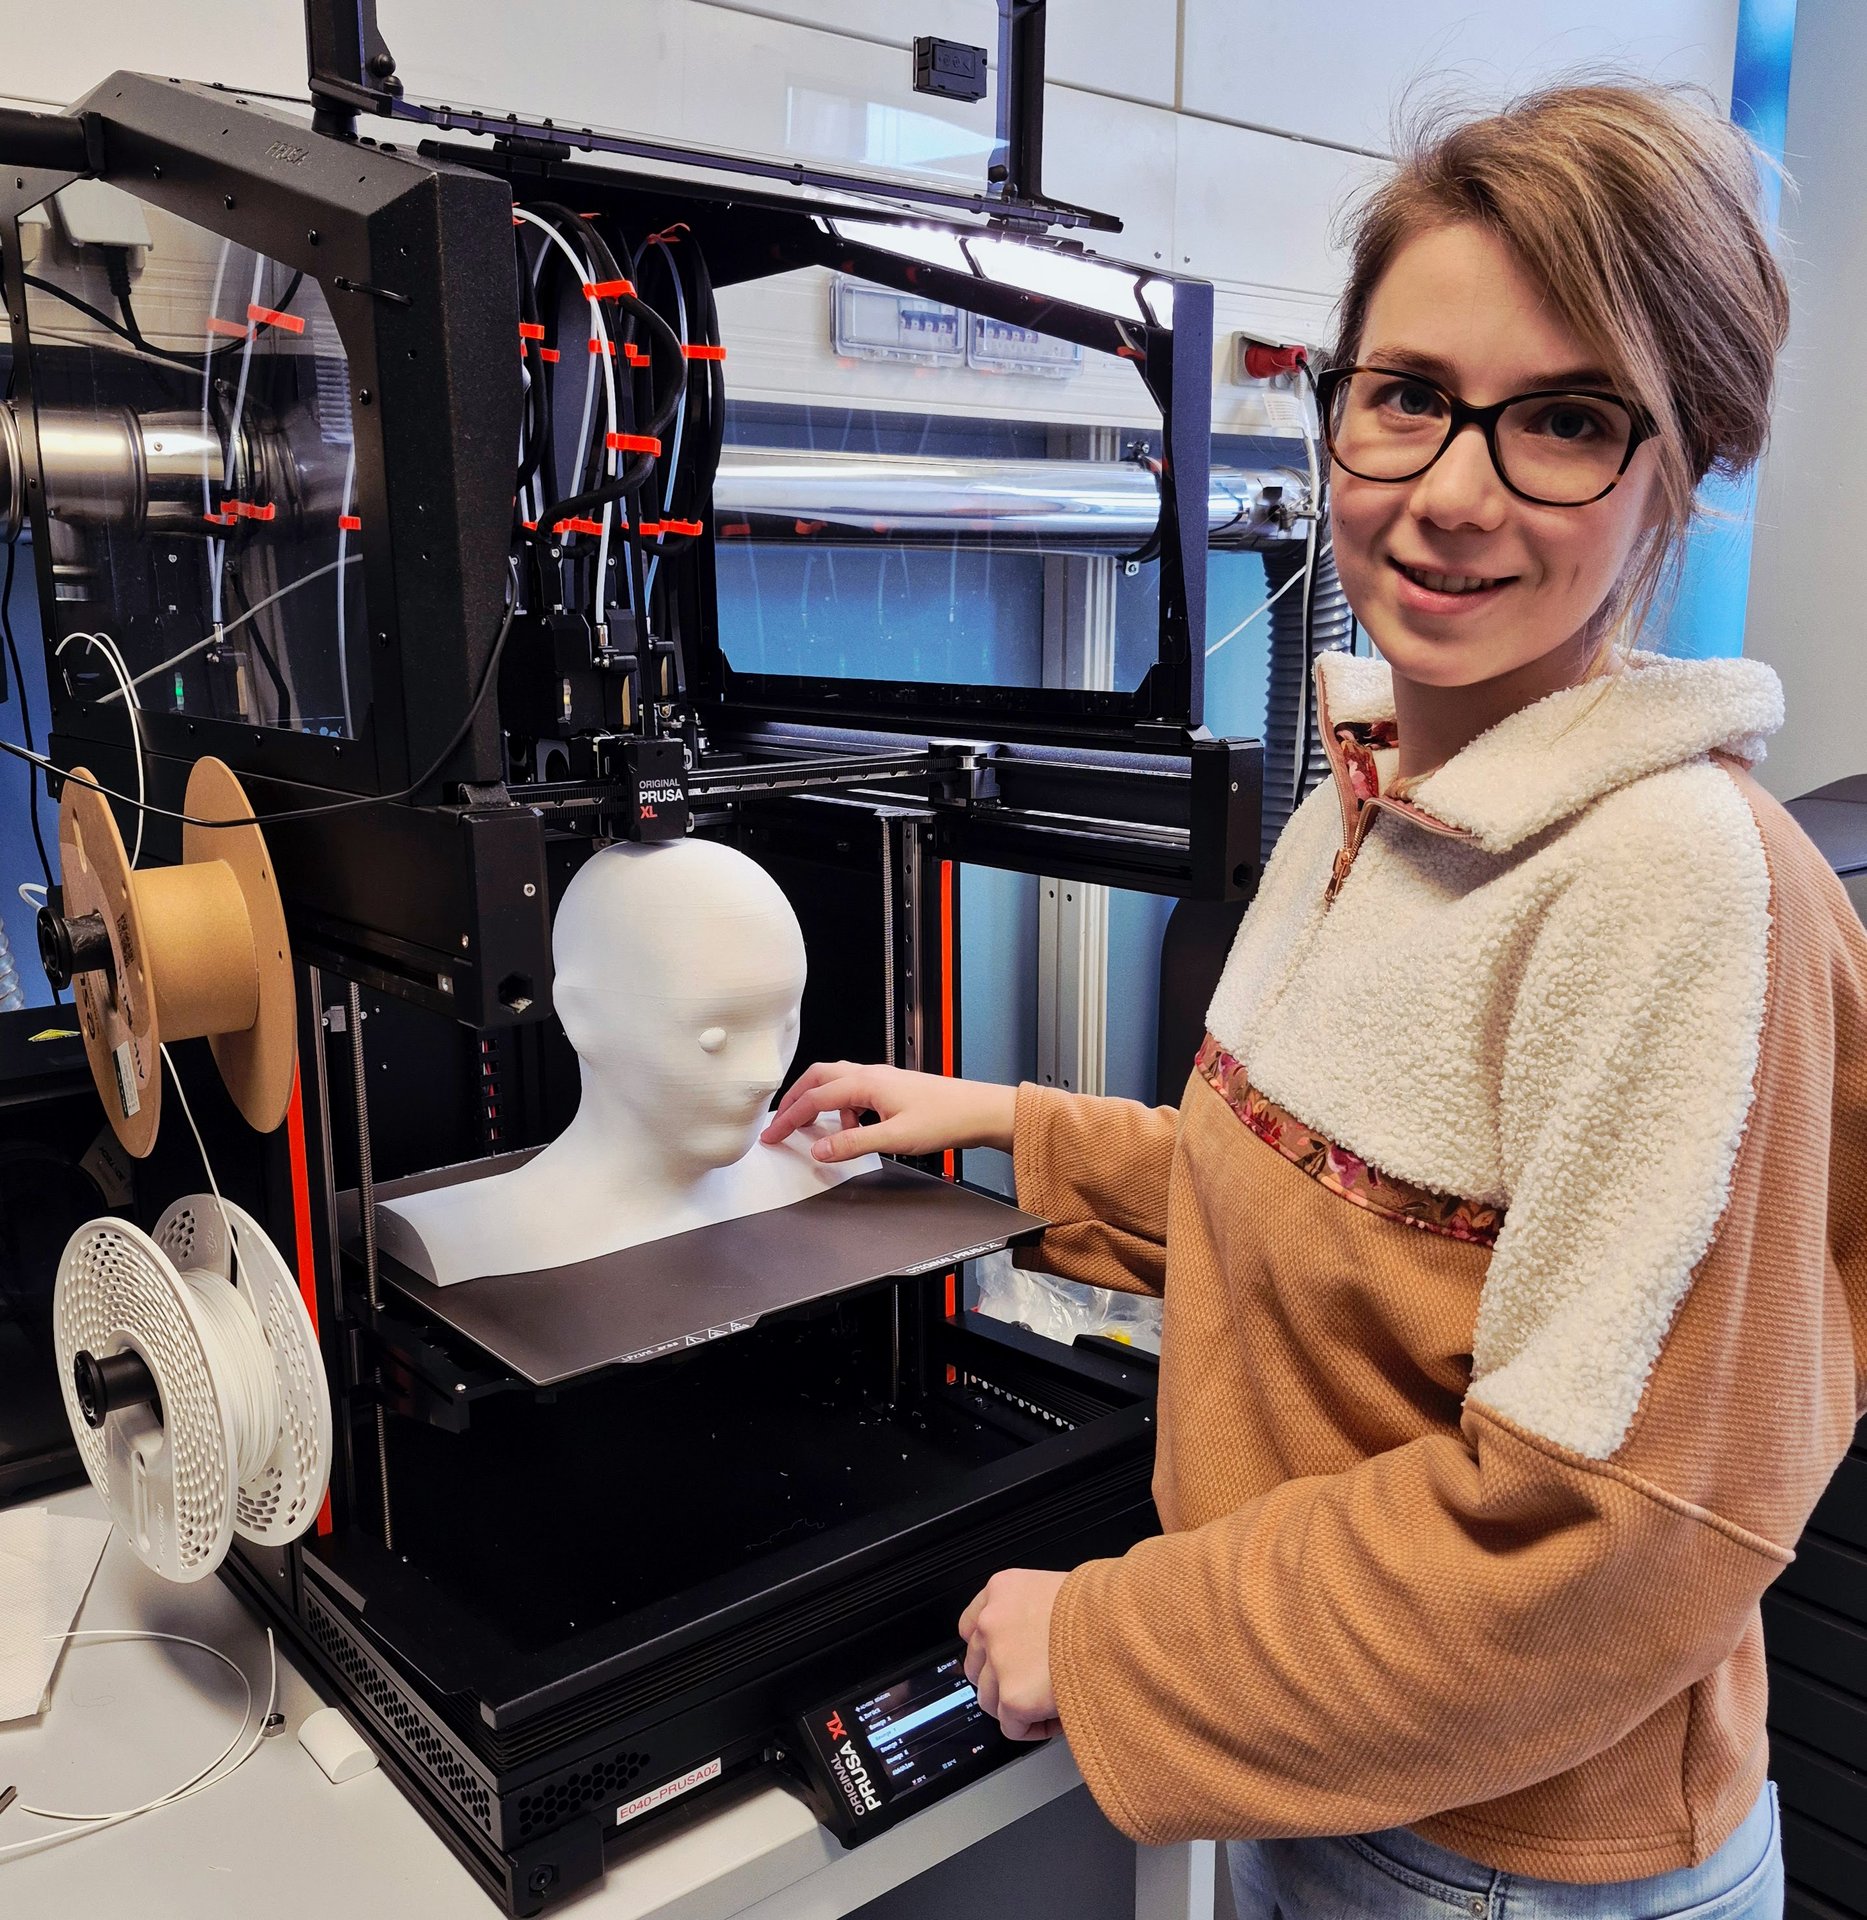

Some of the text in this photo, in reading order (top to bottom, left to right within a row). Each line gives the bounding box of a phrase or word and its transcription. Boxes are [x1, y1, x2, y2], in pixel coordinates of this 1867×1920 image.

[639, 778, 680, 789] ORIGINAL
[639, 788, 685, 803] PRUSA
[640, 805, 658, 819] XL
[826, 1710, 848, 1741] XL
[620, 1762, 719, 1819] E040-PRUSA02
[829, 1752, 866, 1817] ORIGINAL
[839, 1739, 883, 1812] PRUSA
